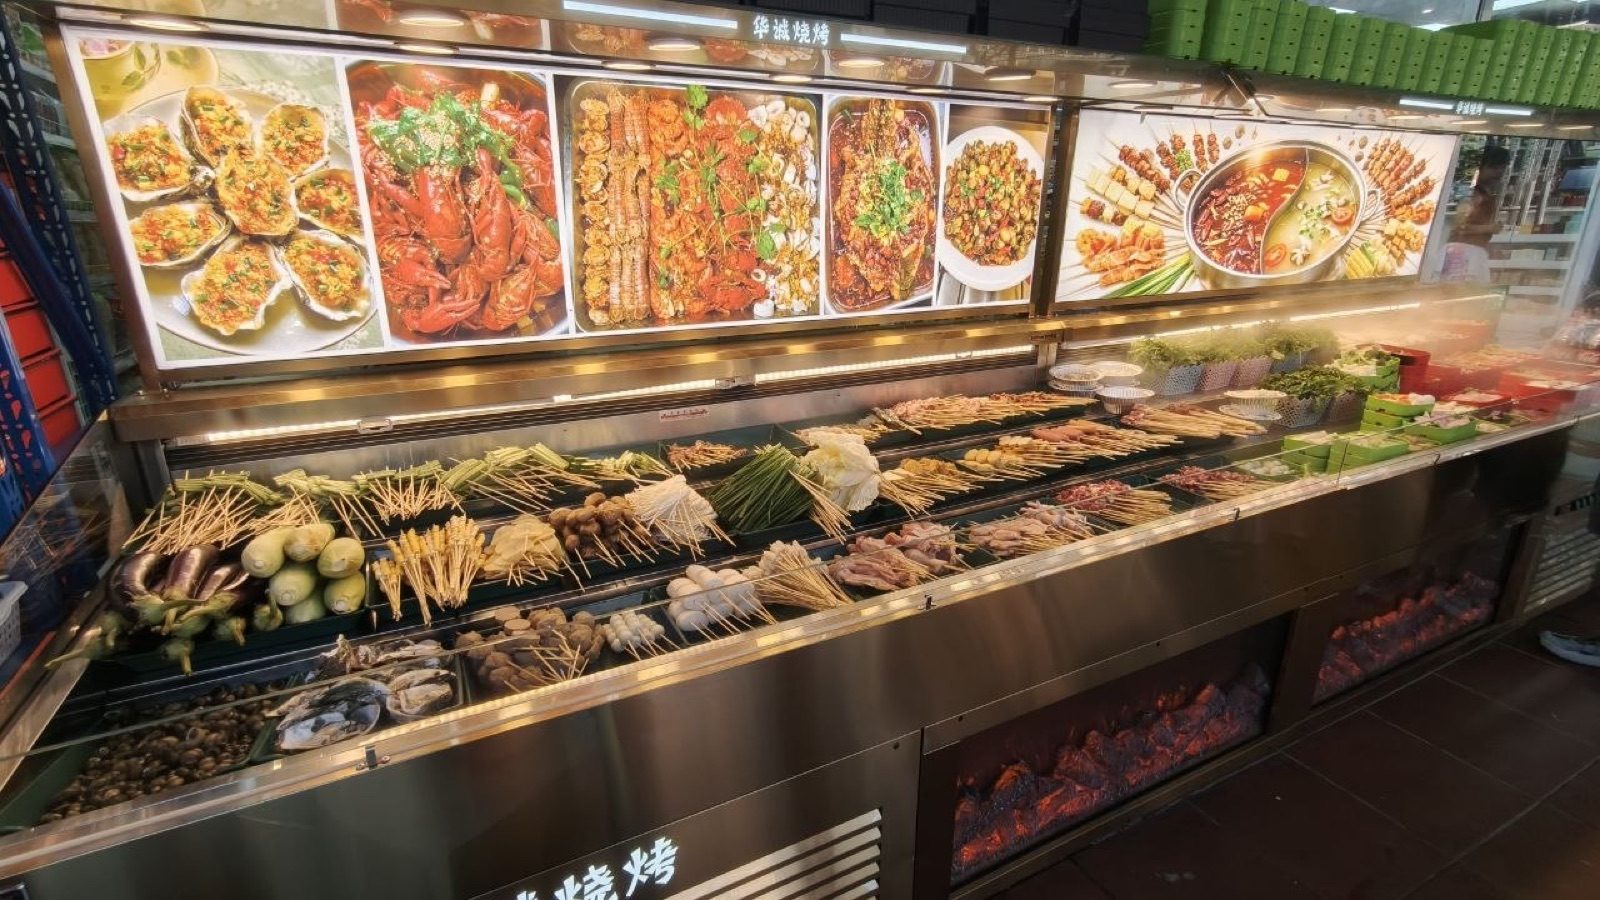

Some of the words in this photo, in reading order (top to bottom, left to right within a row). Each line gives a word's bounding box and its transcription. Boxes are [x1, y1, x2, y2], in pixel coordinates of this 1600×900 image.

[753, 15, 830, 46] 华诚烧烤
[516, 836, 679, 900] 烧烤
